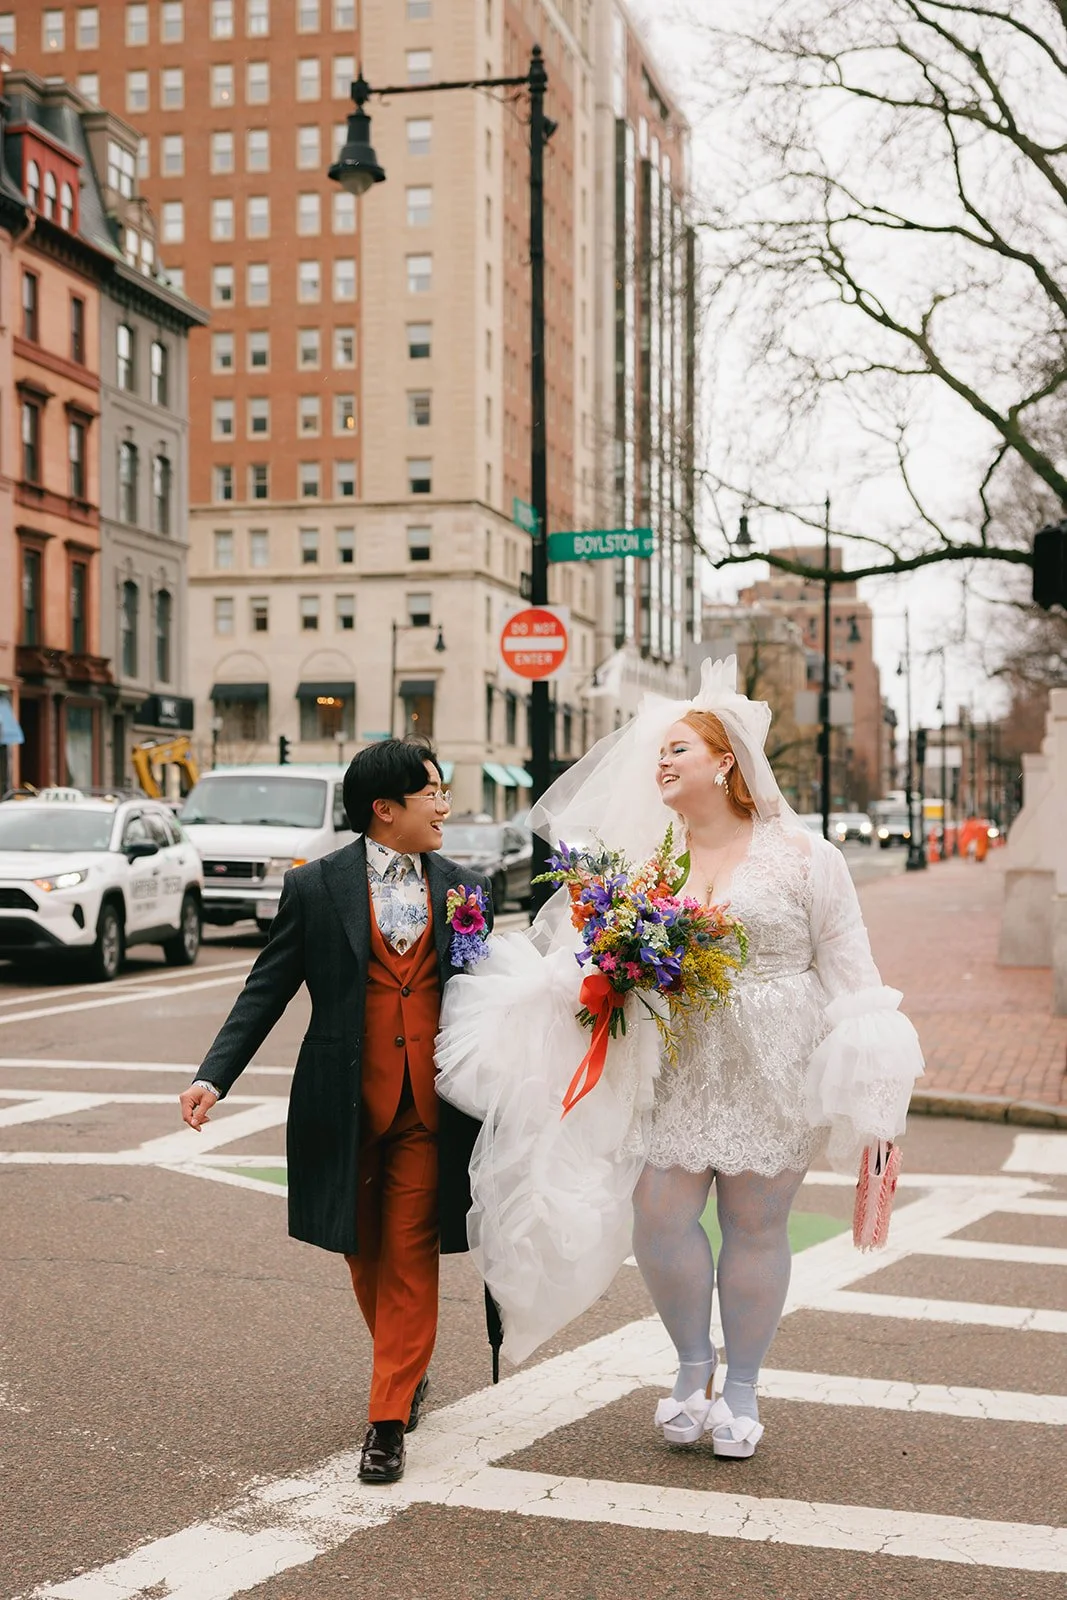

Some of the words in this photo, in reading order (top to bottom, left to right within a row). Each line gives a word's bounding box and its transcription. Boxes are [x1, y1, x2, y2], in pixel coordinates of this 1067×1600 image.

[574, 534, 639, 554] BOYLSTON
[511, 622, 528, 635] DO
[533, 622, 556, 635] NOT
[514, 653, 553, 666] ENTER
[45, 792, 76, 802] TAXI
